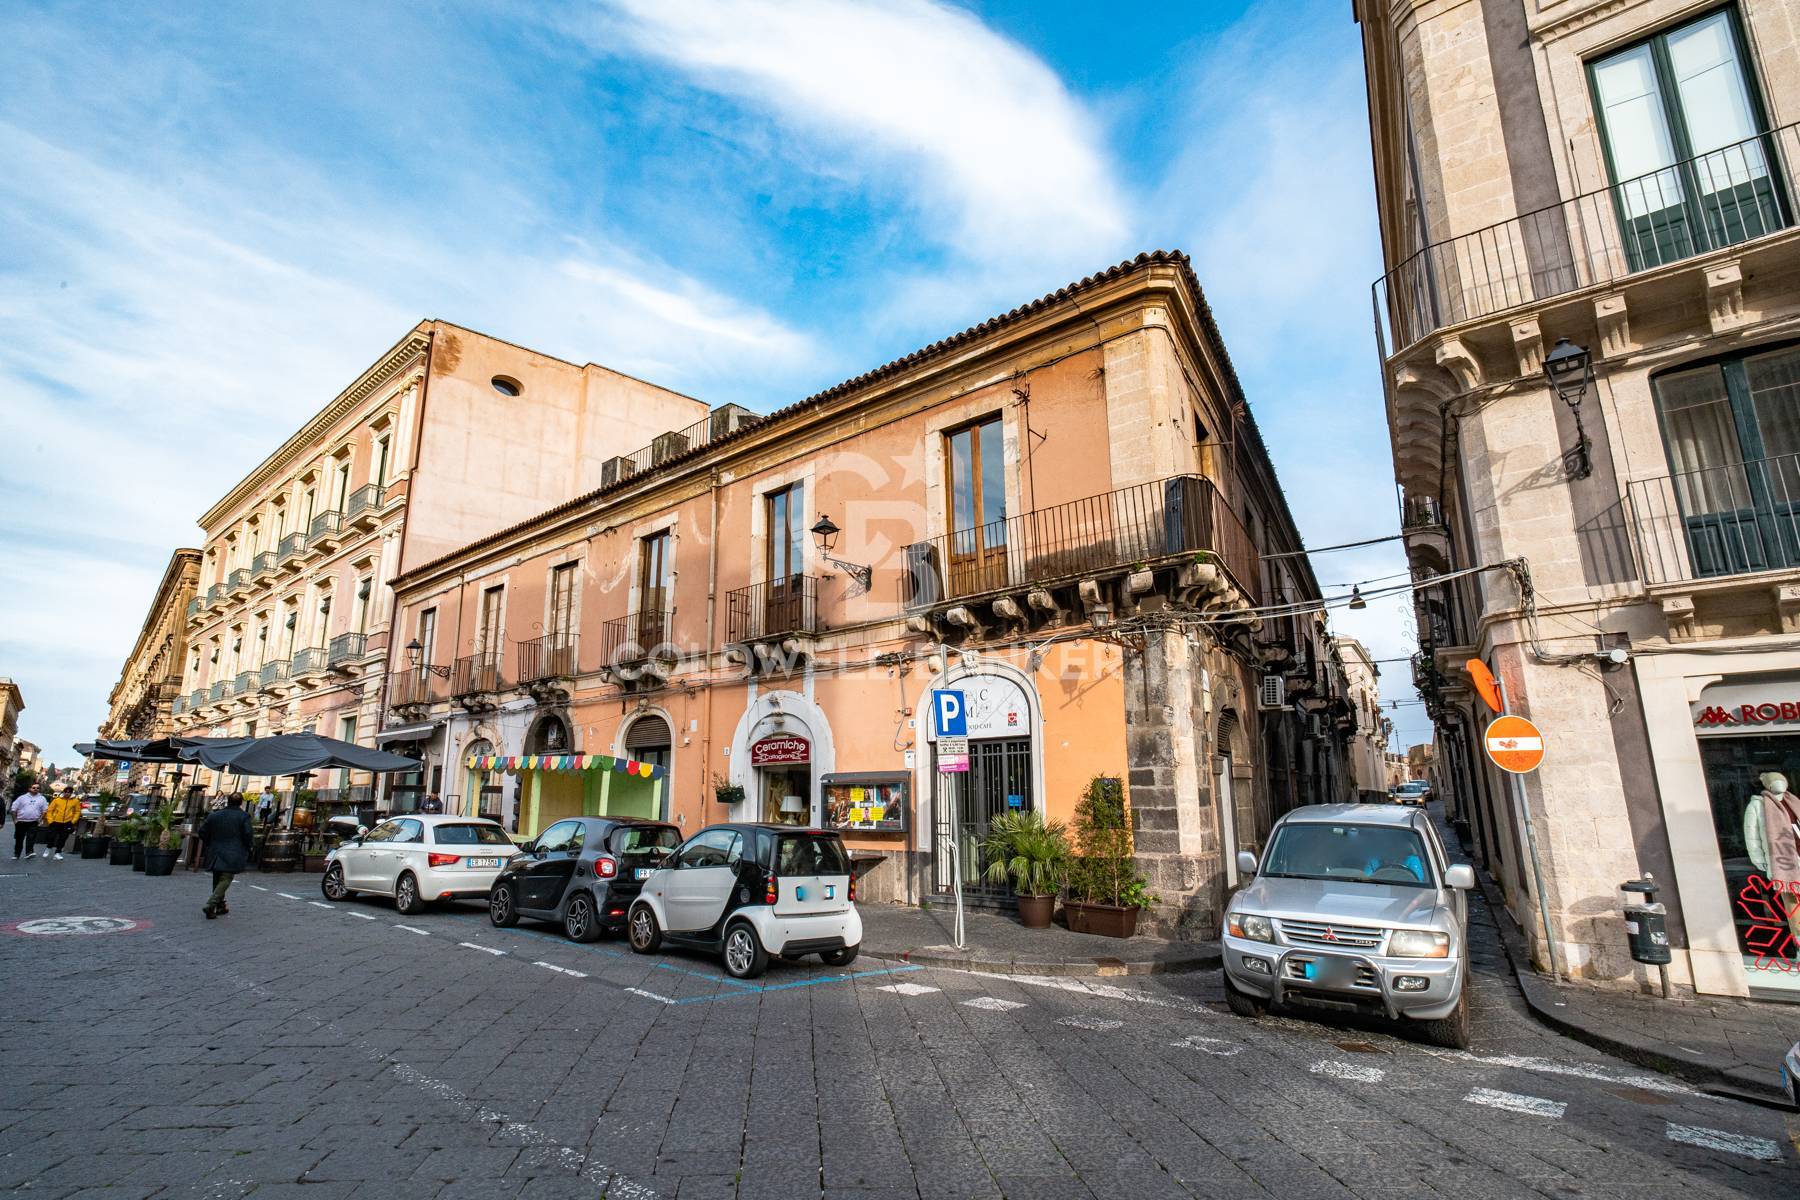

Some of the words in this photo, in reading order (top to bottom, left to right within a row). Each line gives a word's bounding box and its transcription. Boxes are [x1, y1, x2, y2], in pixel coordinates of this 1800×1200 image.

[940, 694, 960, 732] P
[1740, 702, 1800, 723] ROB
[755, 739, 806, 754] Ceramiche
[120, 761, 129, 769] P
[31, 918, 126, 932] 30
